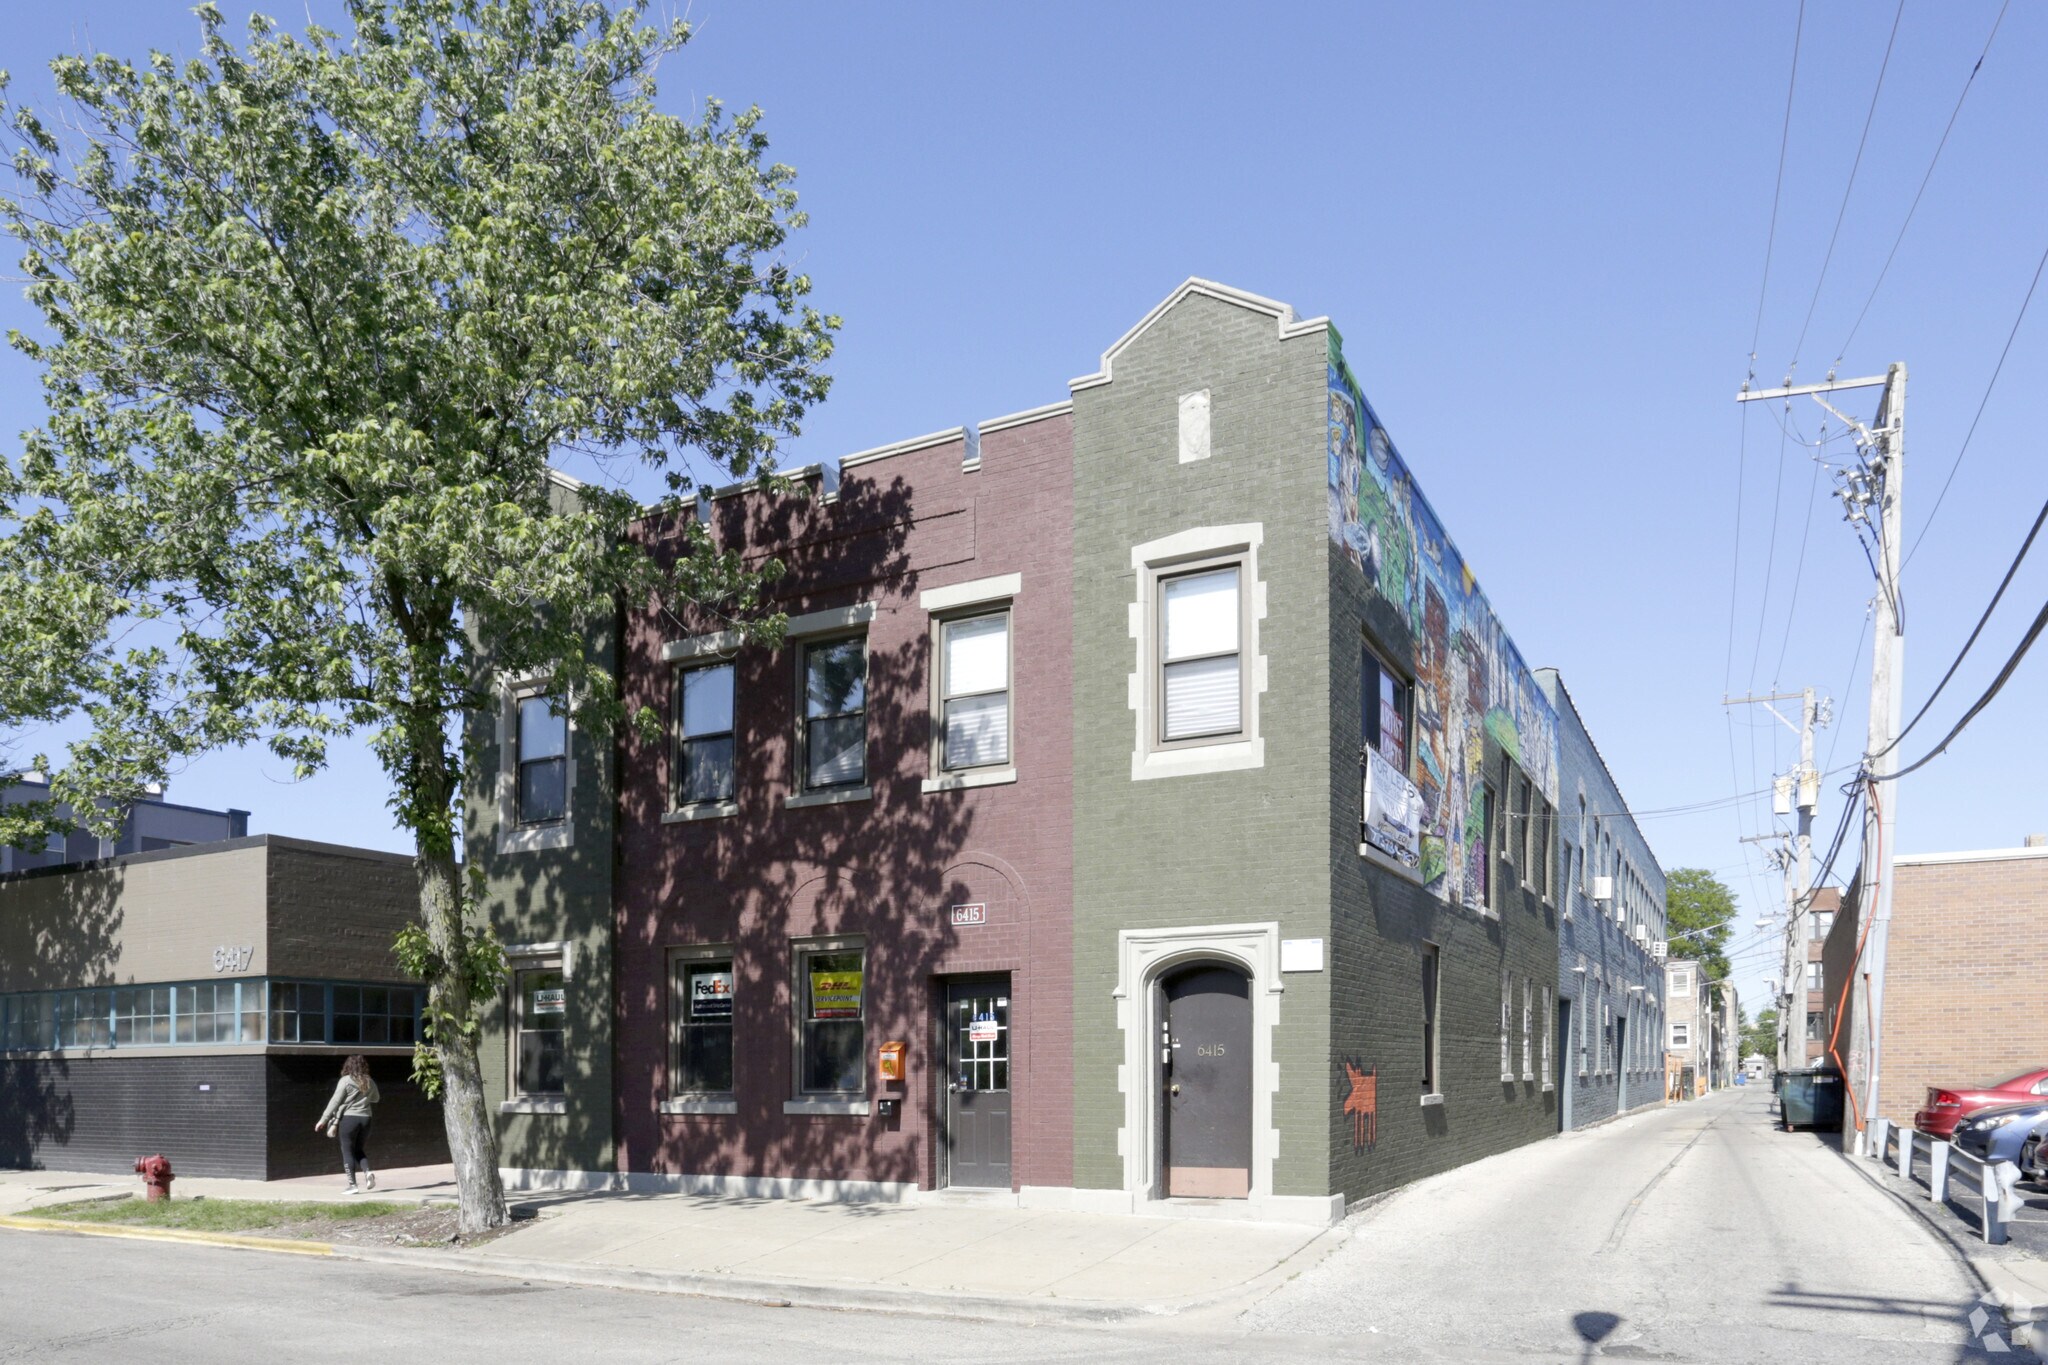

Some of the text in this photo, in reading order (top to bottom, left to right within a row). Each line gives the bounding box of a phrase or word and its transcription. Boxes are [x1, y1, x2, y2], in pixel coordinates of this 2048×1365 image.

[1371, 752, 1388, 779] FOR
[956, 907, 980, 921] 6415
[213, 945, 254, 973] 6417
[695, 980, 730, 995] FedEx
[820, 982, 849, 990] DHL
[1197, 1043, 1225, 1056] 6415
